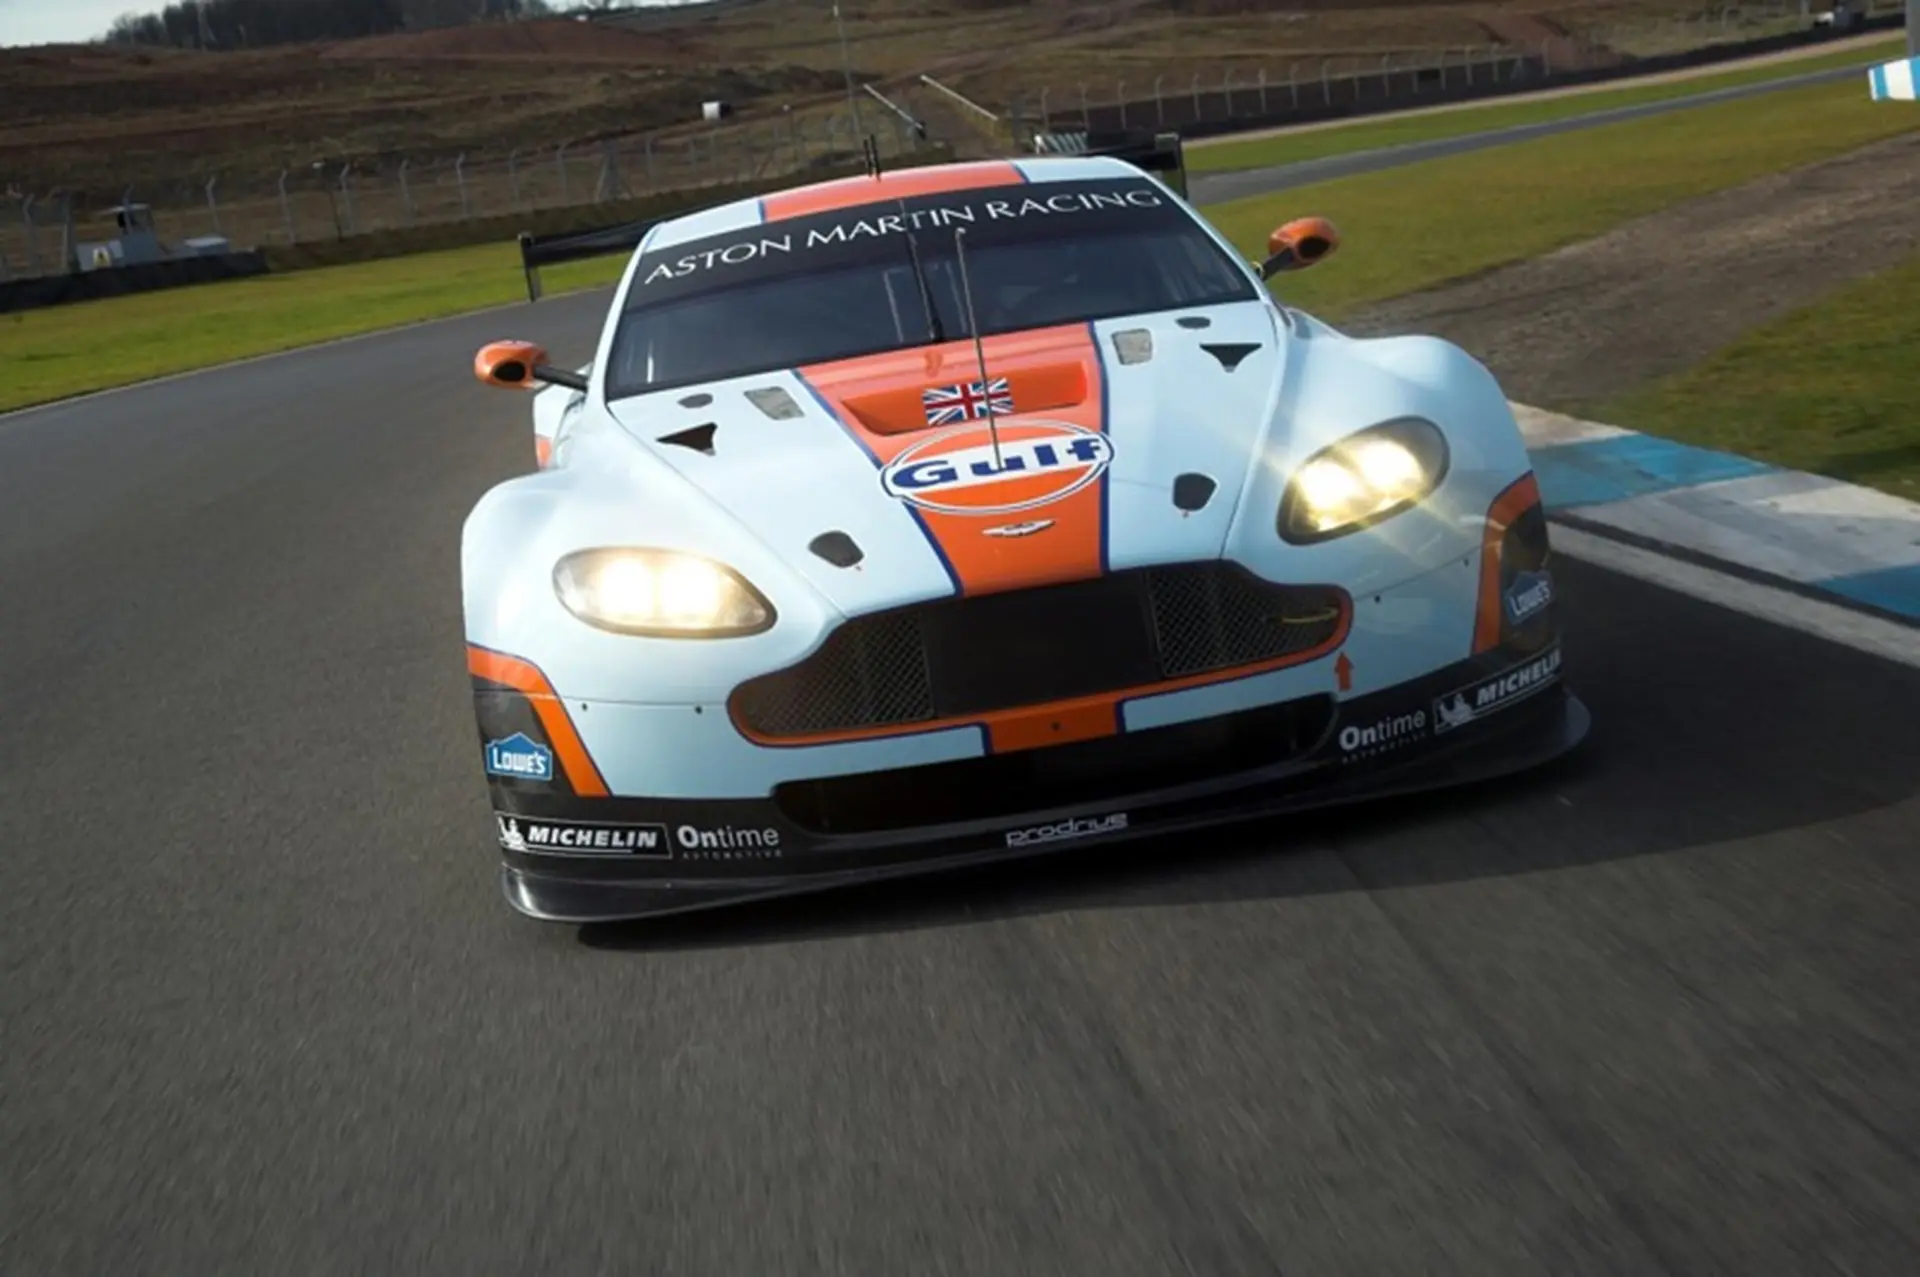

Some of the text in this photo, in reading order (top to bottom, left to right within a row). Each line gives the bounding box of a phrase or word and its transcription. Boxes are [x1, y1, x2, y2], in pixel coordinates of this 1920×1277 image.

[643, 189, 1162, 285] ASTON MARTIN RACING
[891, 437, 1102, 488] Gulf
[1338, 709, 1426, 751] Ontime
[492, 748, 547, 775] LOWE'S
[527, 825, 658, 849] MICHELIN
[676, 825, 779, 849] Ontime
